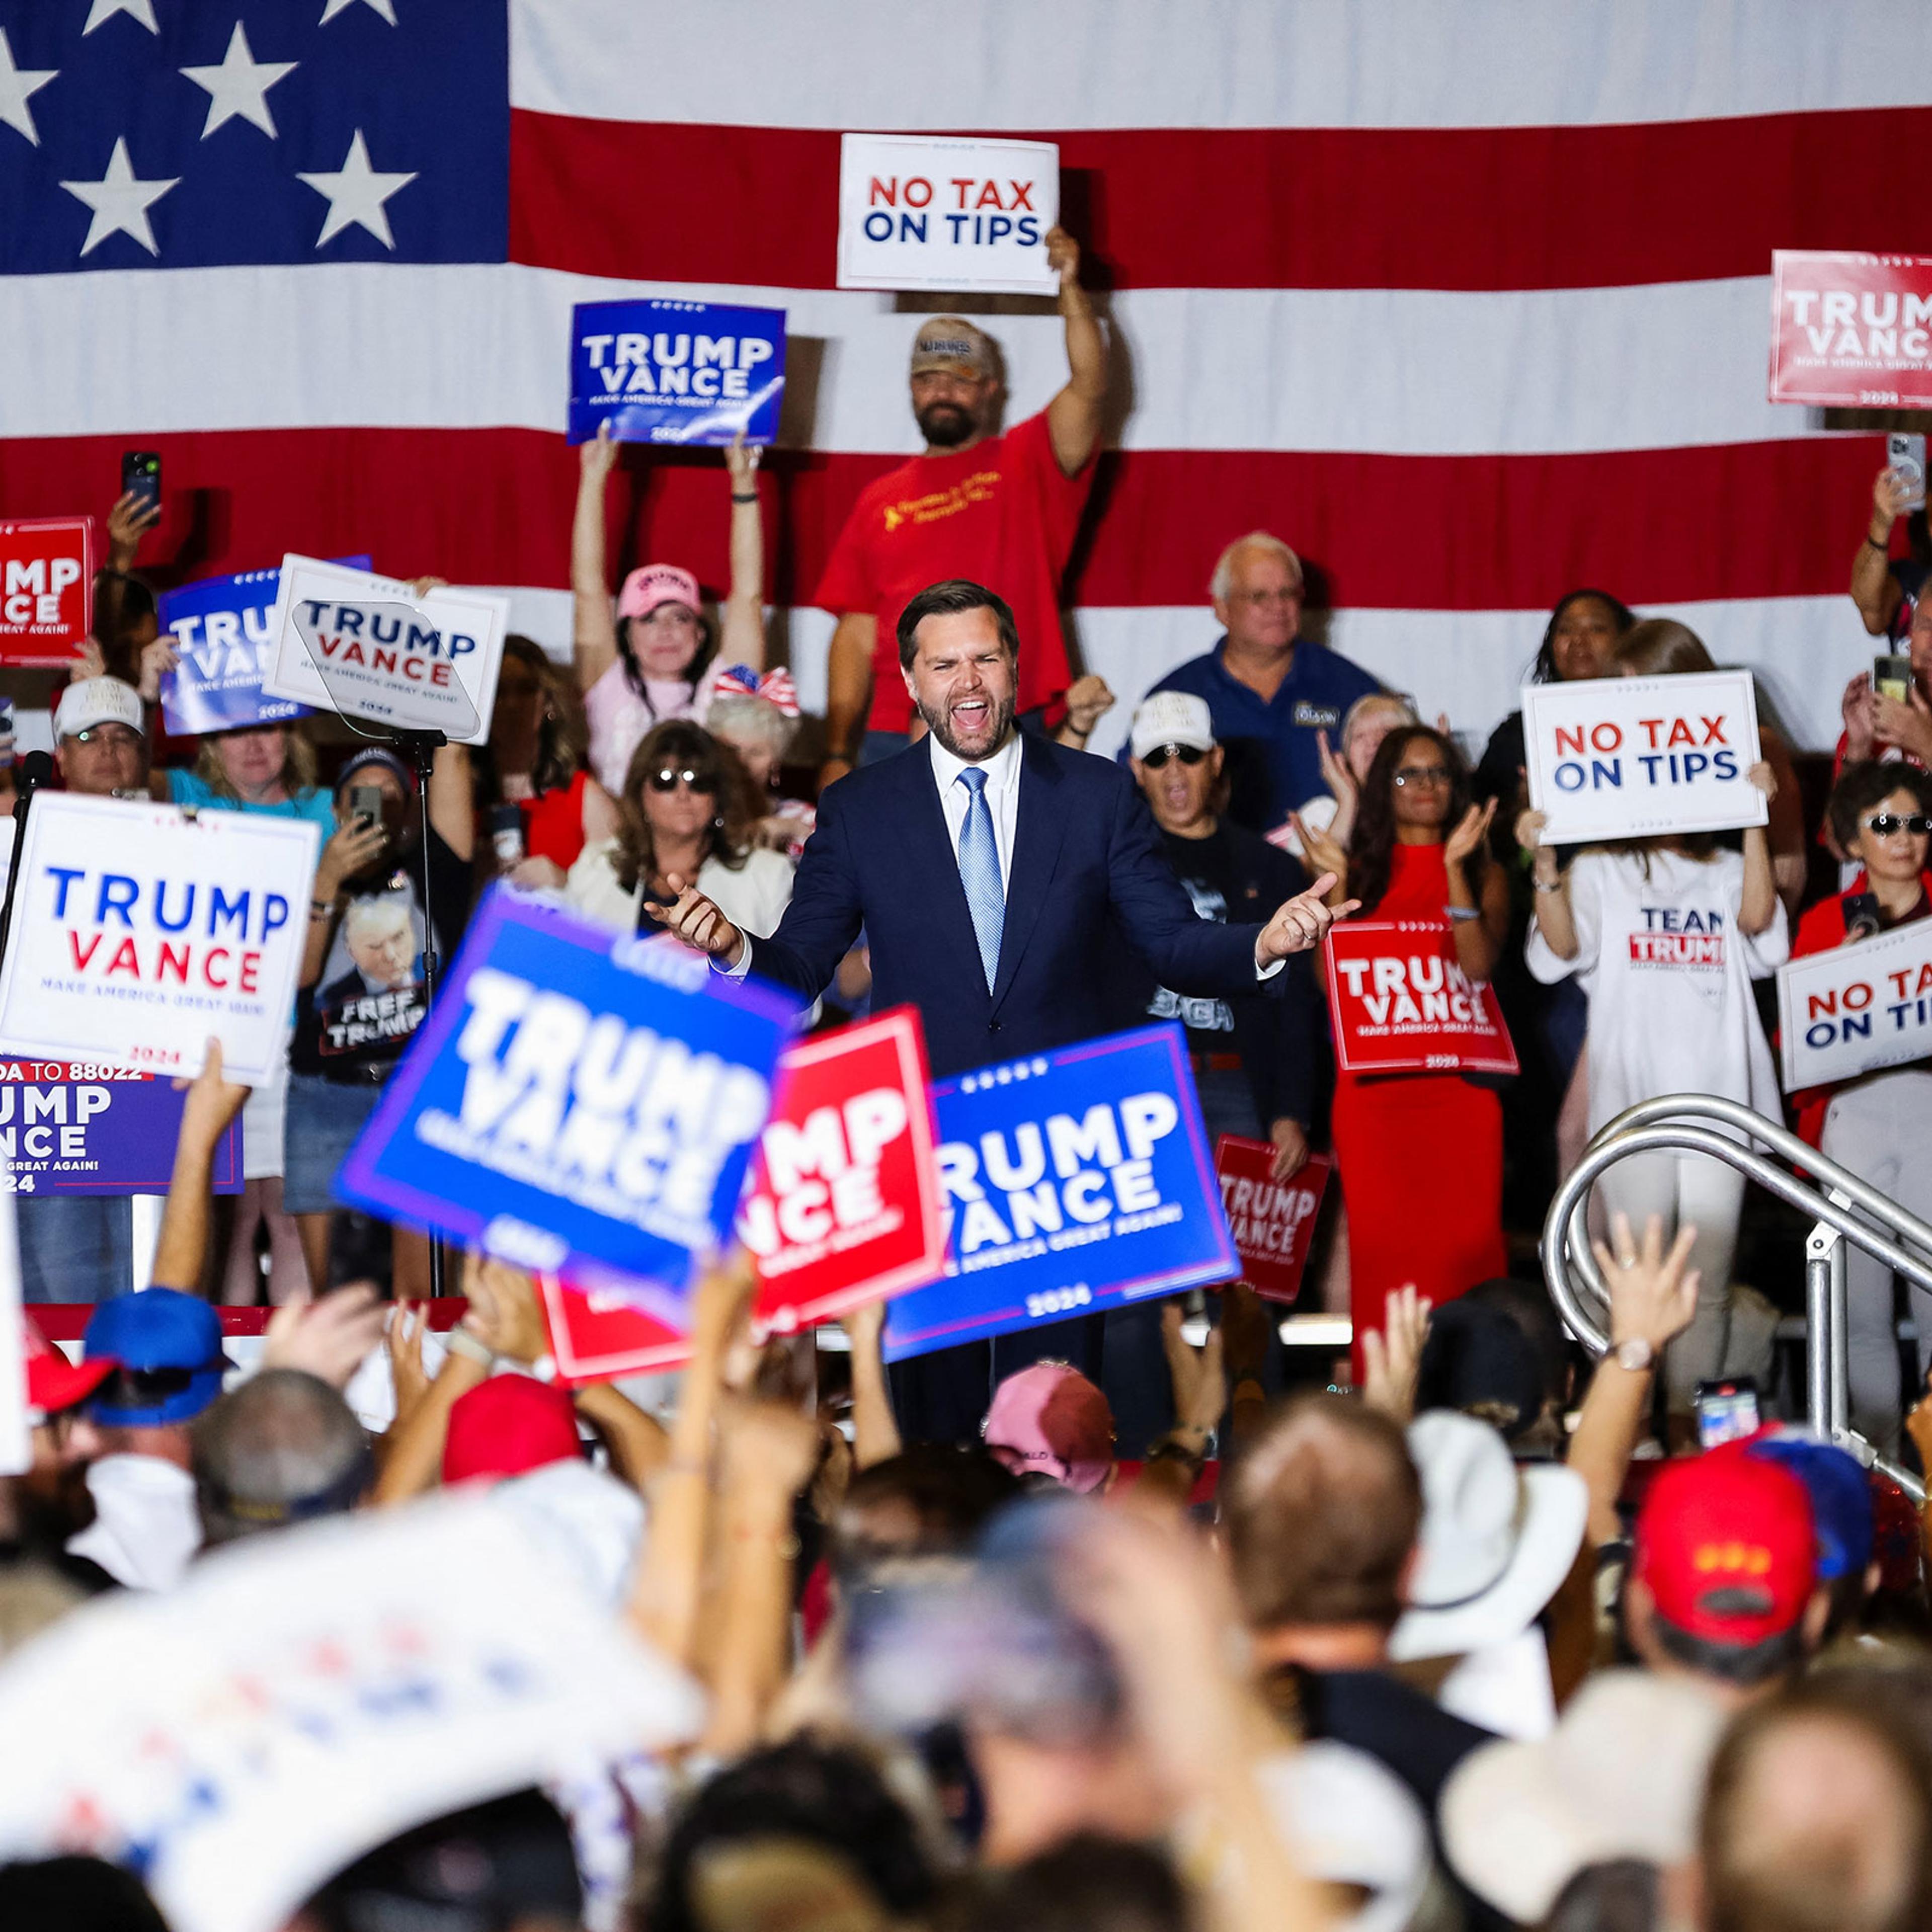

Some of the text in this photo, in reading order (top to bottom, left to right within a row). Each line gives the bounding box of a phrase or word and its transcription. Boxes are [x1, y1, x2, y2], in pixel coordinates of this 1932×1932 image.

[869, 177, 1034, 211] NO TAX
[864, 212, 1039, 247] ON TIPS
[582, 333, 774, 370] TRUMP
[1806, 325, 1930, 359] VANC
[600, 364, 751, 399] VANCE
[0, 557, 80, 596] MP
[0, 594, 60, 624] CE
[169, 604, 276, 653] TRU
[302, 600, 476, 661] TRUMP
[317, 634, 454, 688] VANCE
[1554, 715, 1729, 756] NO TAX
[1555, 750, 1738, 791] ON TIPS
[43, 866, 290, 944] TRUMP
[67, 929, 261, 994] VANCE
[1337, 955, 1486, 997] TRUM
[341, 988, 415, 1024] FREE
[1808, 963, 1932, 1021] NO TA
[1805, 998, 1932, 1049] ON TI
[30, 1063, 62, 1081] TO
[69, 1063, 142, 1081] 88022
[129, 1045, 182, 1064] 2024
[455, 967, 772, 1150] TRUMP
[458, 1059, 726, 1225] VANCE
[935, 1091, 1178, 1208] RUMP
[6, 1160, 99, 1171] GREAT AGAIN!
[942, 1158, 1161, 1254] ANCE
[1219, 1174, 1316, 1227] TRUMP
[1230, 1214, 1298, 1253] ANCE
[1026, 1281, 1093, 1318] 2024
